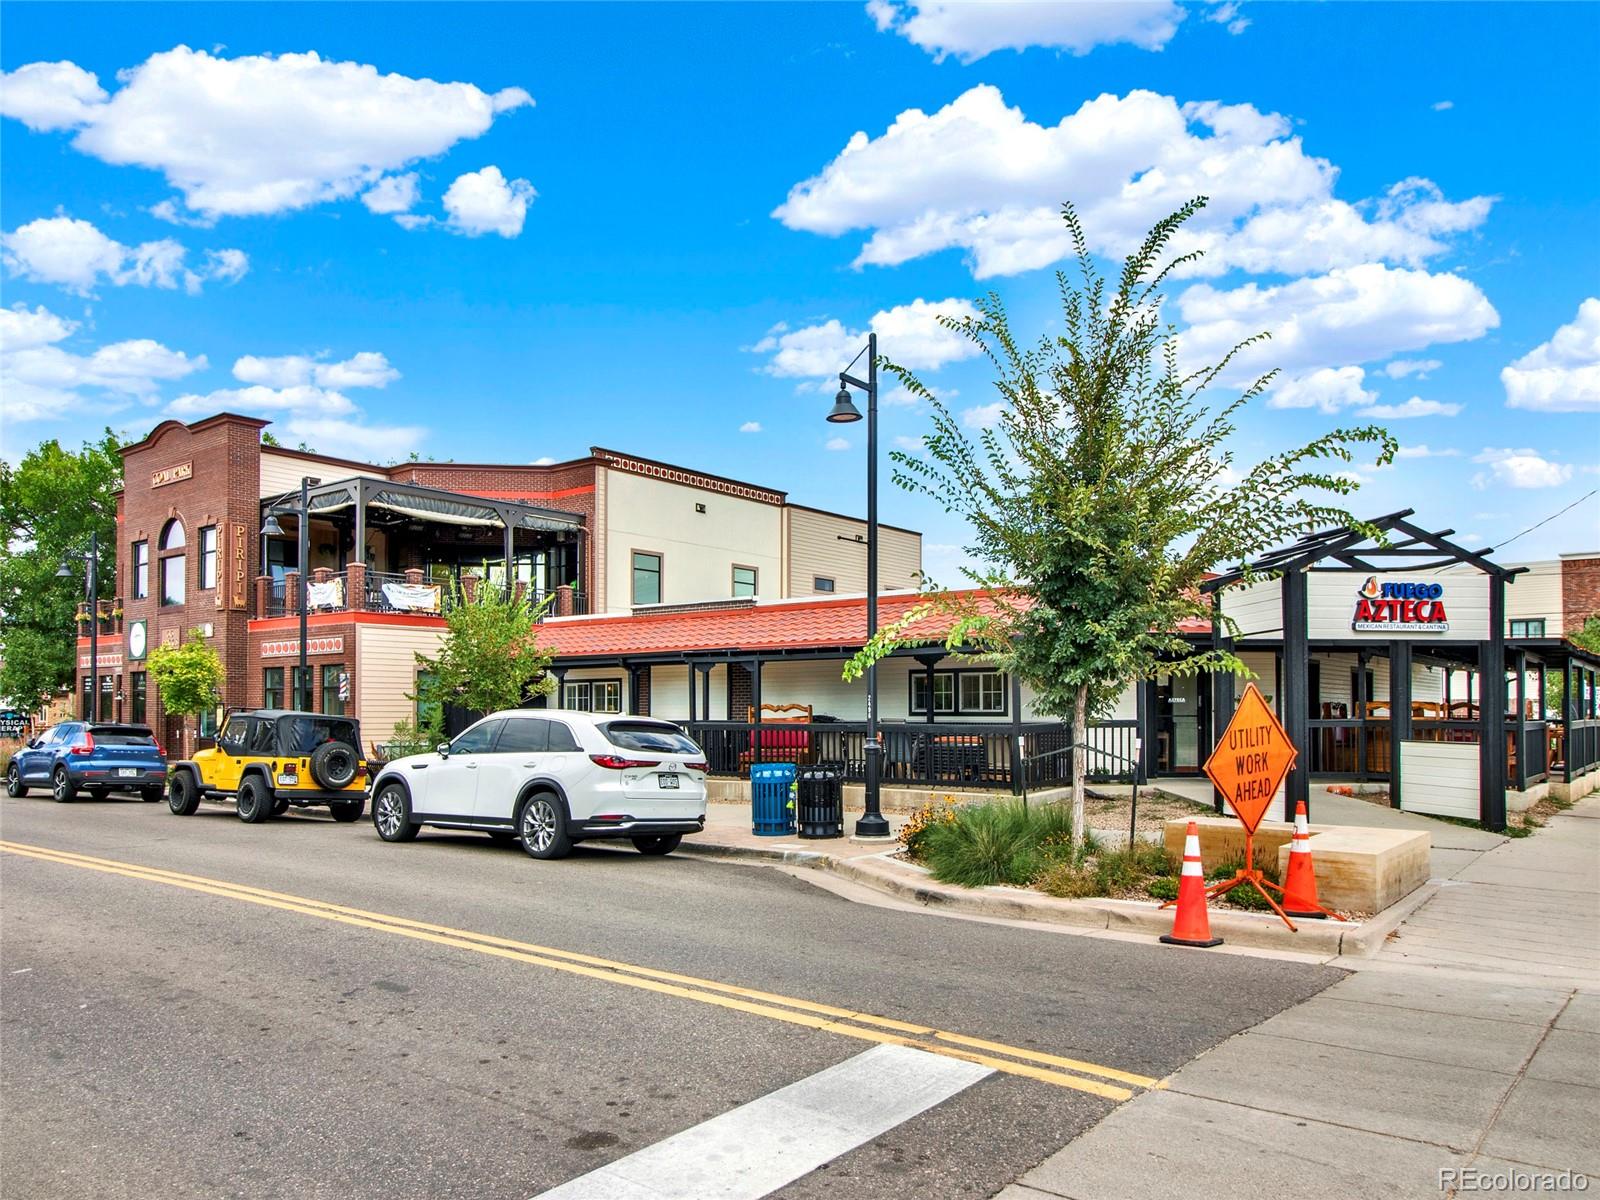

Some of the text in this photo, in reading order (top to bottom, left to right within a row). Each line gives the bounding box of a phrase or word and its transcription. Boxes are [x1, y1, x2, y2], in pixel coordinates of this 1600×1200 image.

[235, 525, 245, 593] PIRIPI
[1381, 583, 1443, 599] FUEGO
[1354, 599, 1448, 622] AZTECA
[1229, 725, 1272, 750] UTILITY
[1236, 752, 1268, 776] WORK
[1235, 778, 1271, 803] AHEAD
